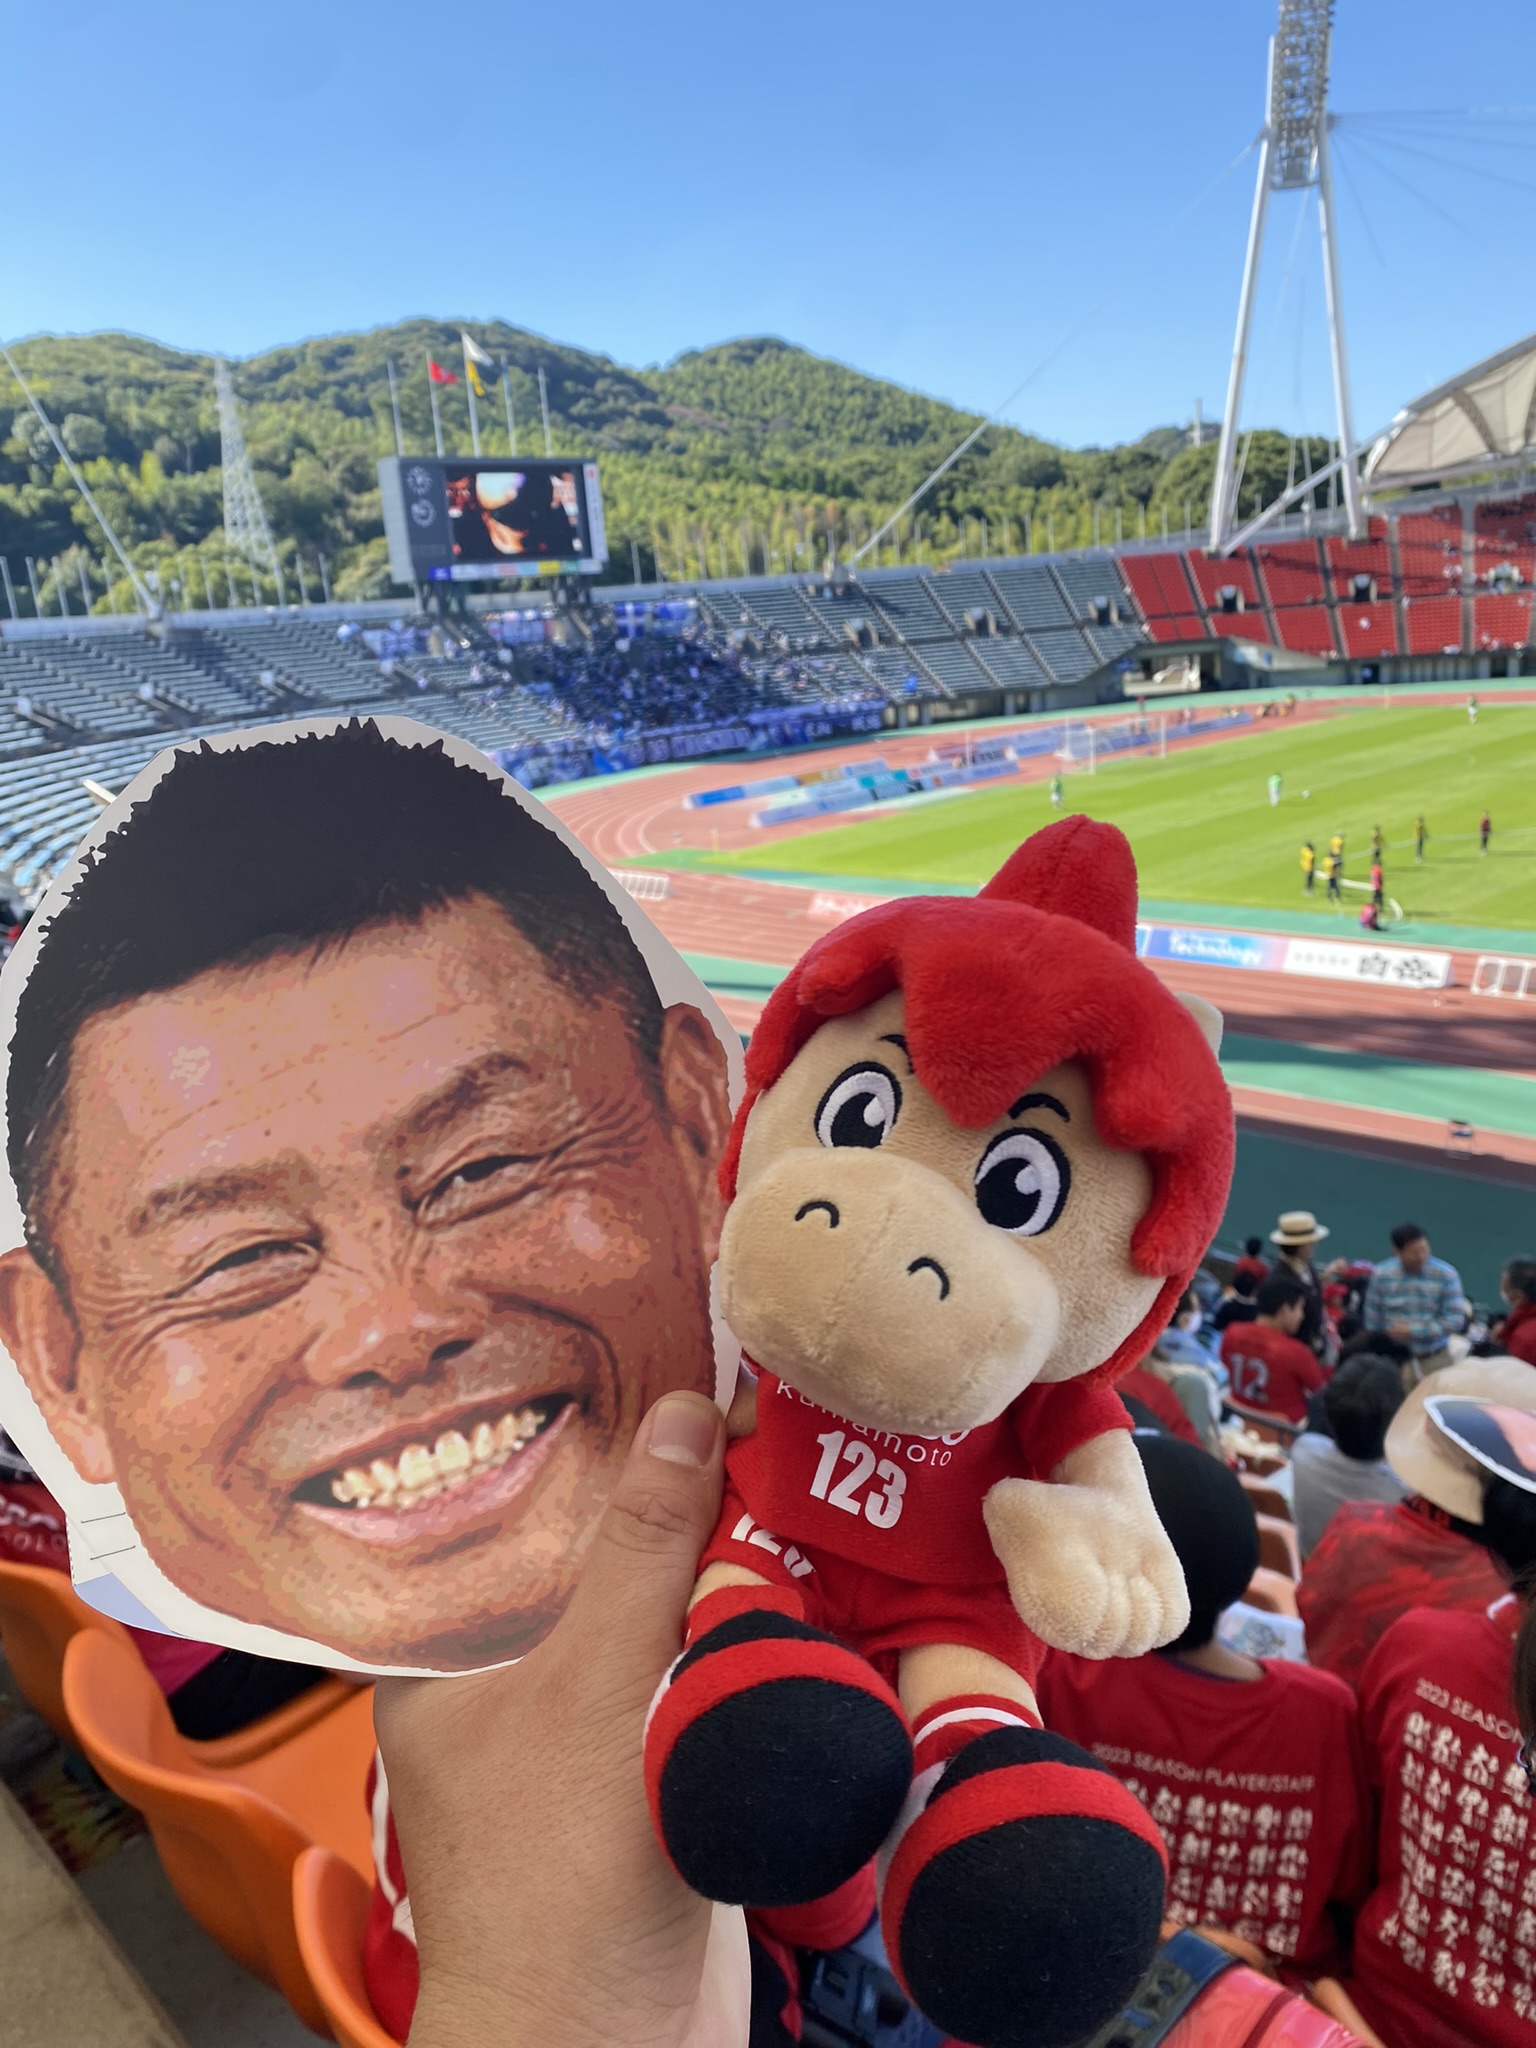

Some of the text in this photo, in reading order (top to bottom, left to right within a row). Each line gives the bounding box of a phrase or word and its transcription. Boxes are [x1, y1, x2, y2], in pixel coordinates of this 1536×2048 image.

[1169, 940, 1262, 966] Technology
[1229, 1352, 1270, 1404] 12
[776, 1380, 952, 1467] Kuamoto
[809, 1430, 907, 1529] 123
[1415, 1676, 1450, 1710] 2023
[1092, 1742, 1317, 1793] 2023 SEASON PLAYER/STAFF
